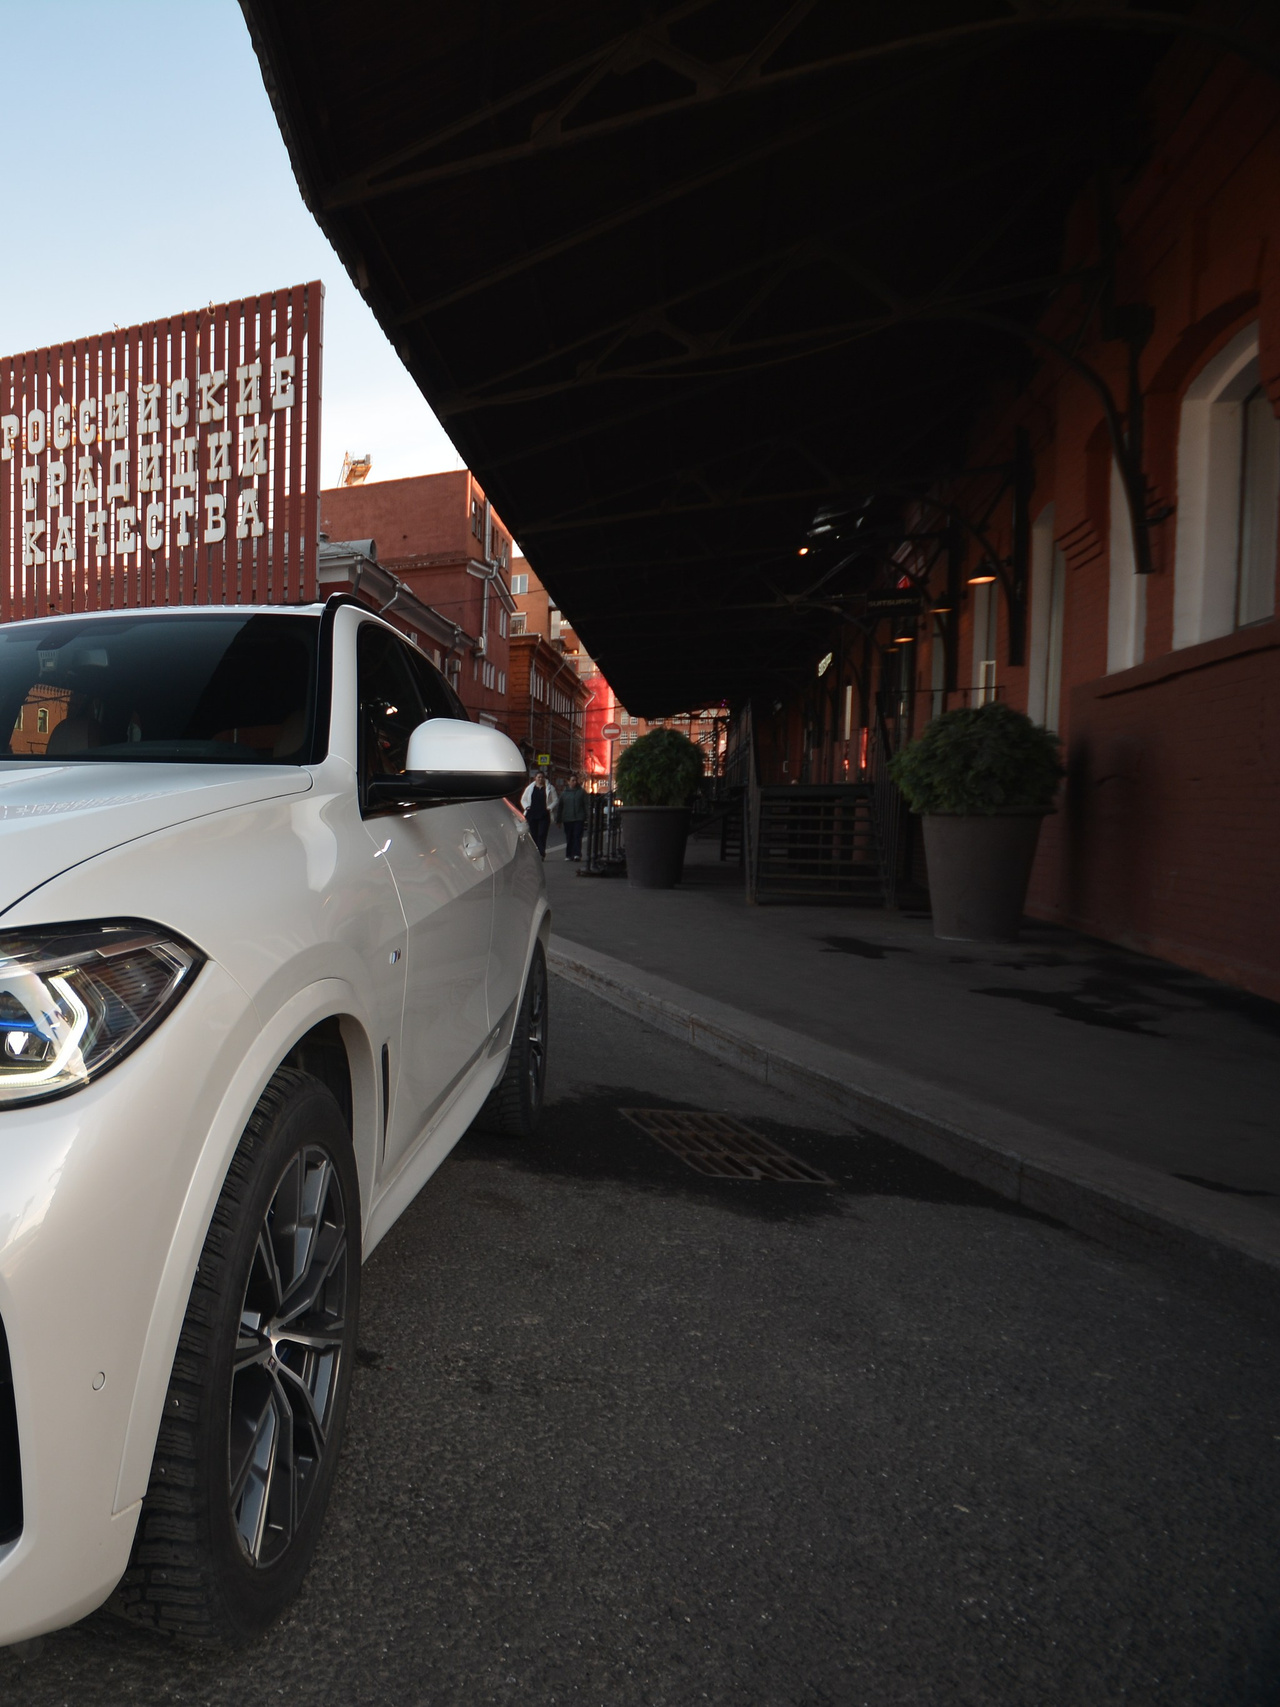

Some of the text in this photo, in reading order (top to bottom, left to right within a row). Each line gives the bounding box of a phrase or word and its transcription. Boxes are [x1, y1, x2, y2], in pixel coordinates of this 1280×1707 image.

[0, 355, 296, 461] РОССИЙСКИЕ
[21, 423, 269, 511] ТРАДИЦИИ
[23, 488, 265, 566] КАЧЕСТВА
